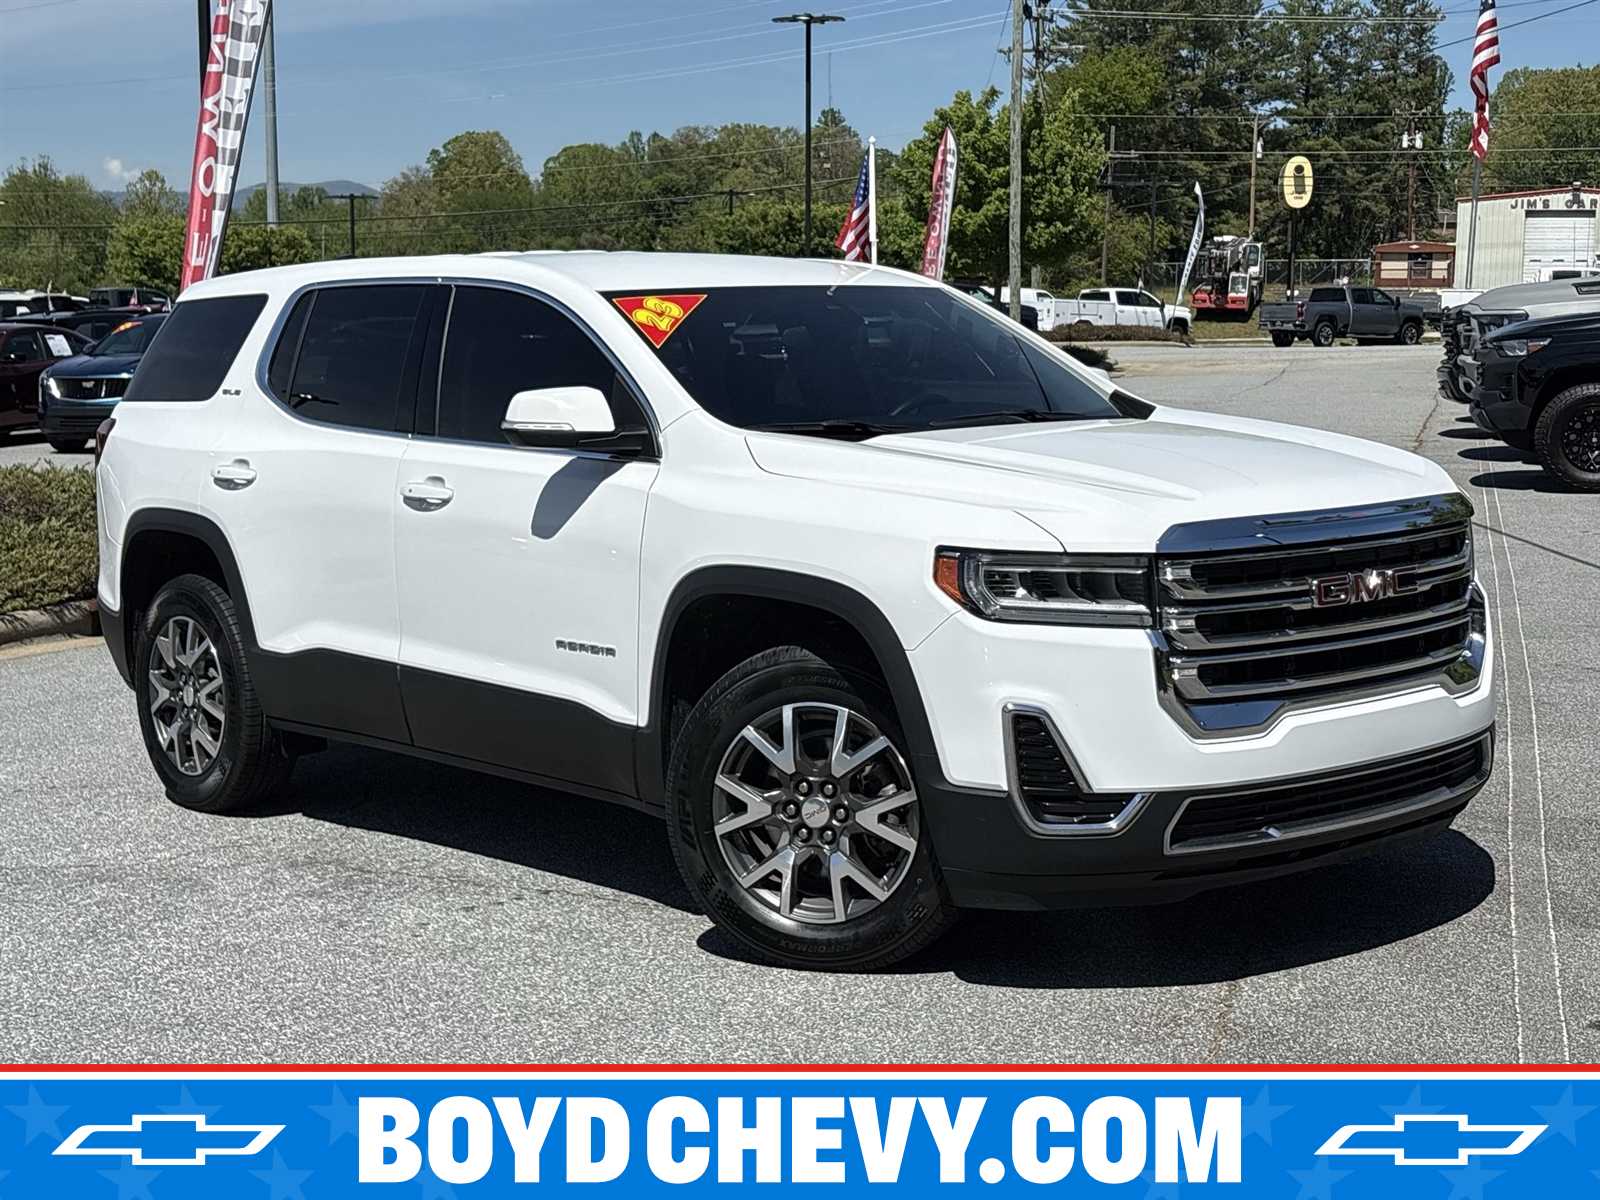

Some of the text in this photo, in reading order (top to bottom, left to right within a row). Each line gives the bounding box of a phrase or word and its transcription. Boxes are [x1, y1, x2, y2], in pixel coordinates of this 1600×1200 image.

[1510, 198, 1550, 209] JIM'S
[1313, 564, 1420, 608] GMC
[555, 639, 616, 657] ACADIA
